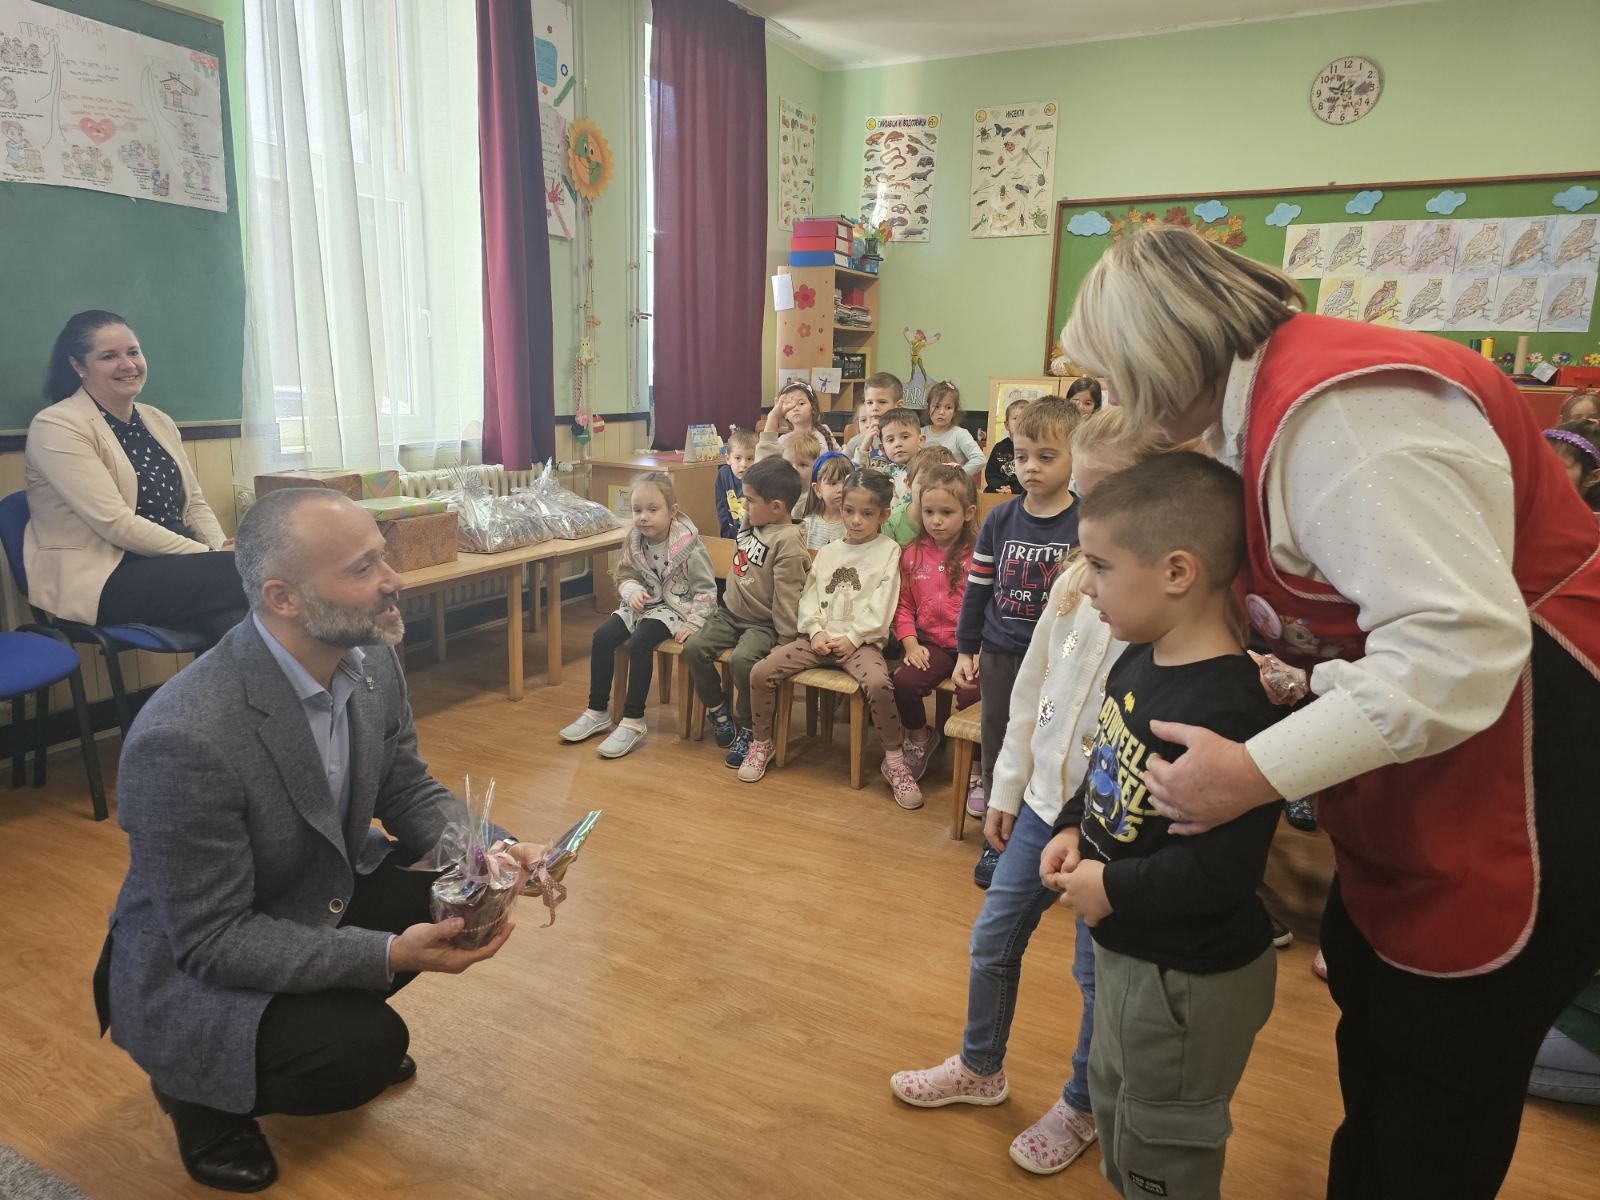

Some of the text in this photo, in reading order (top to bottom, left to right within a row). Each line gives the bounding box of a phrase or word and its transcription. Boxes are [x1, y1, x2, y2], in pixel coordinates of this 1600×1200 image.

[1330, 64, 1338, 74] 11
[1344, 60, 1353, 69] 12
[1367, 70, 1373, 79] 2
[1321, 75, 1330, 84] 10
[1316, 89, 1322, 98] 9
[1318, 102, 1324, 110] 8
[1005, 109, 1025, 118] ИНСЕКТИ
[1354, 108, 1359, 116] 5
[1340, 113, 1346, 122] 6
[1008, 544, 1063, 562] PRETTY
[1002, 559, 1063, 589] FLY
[1010, 589, 1049, 602] FOR A
